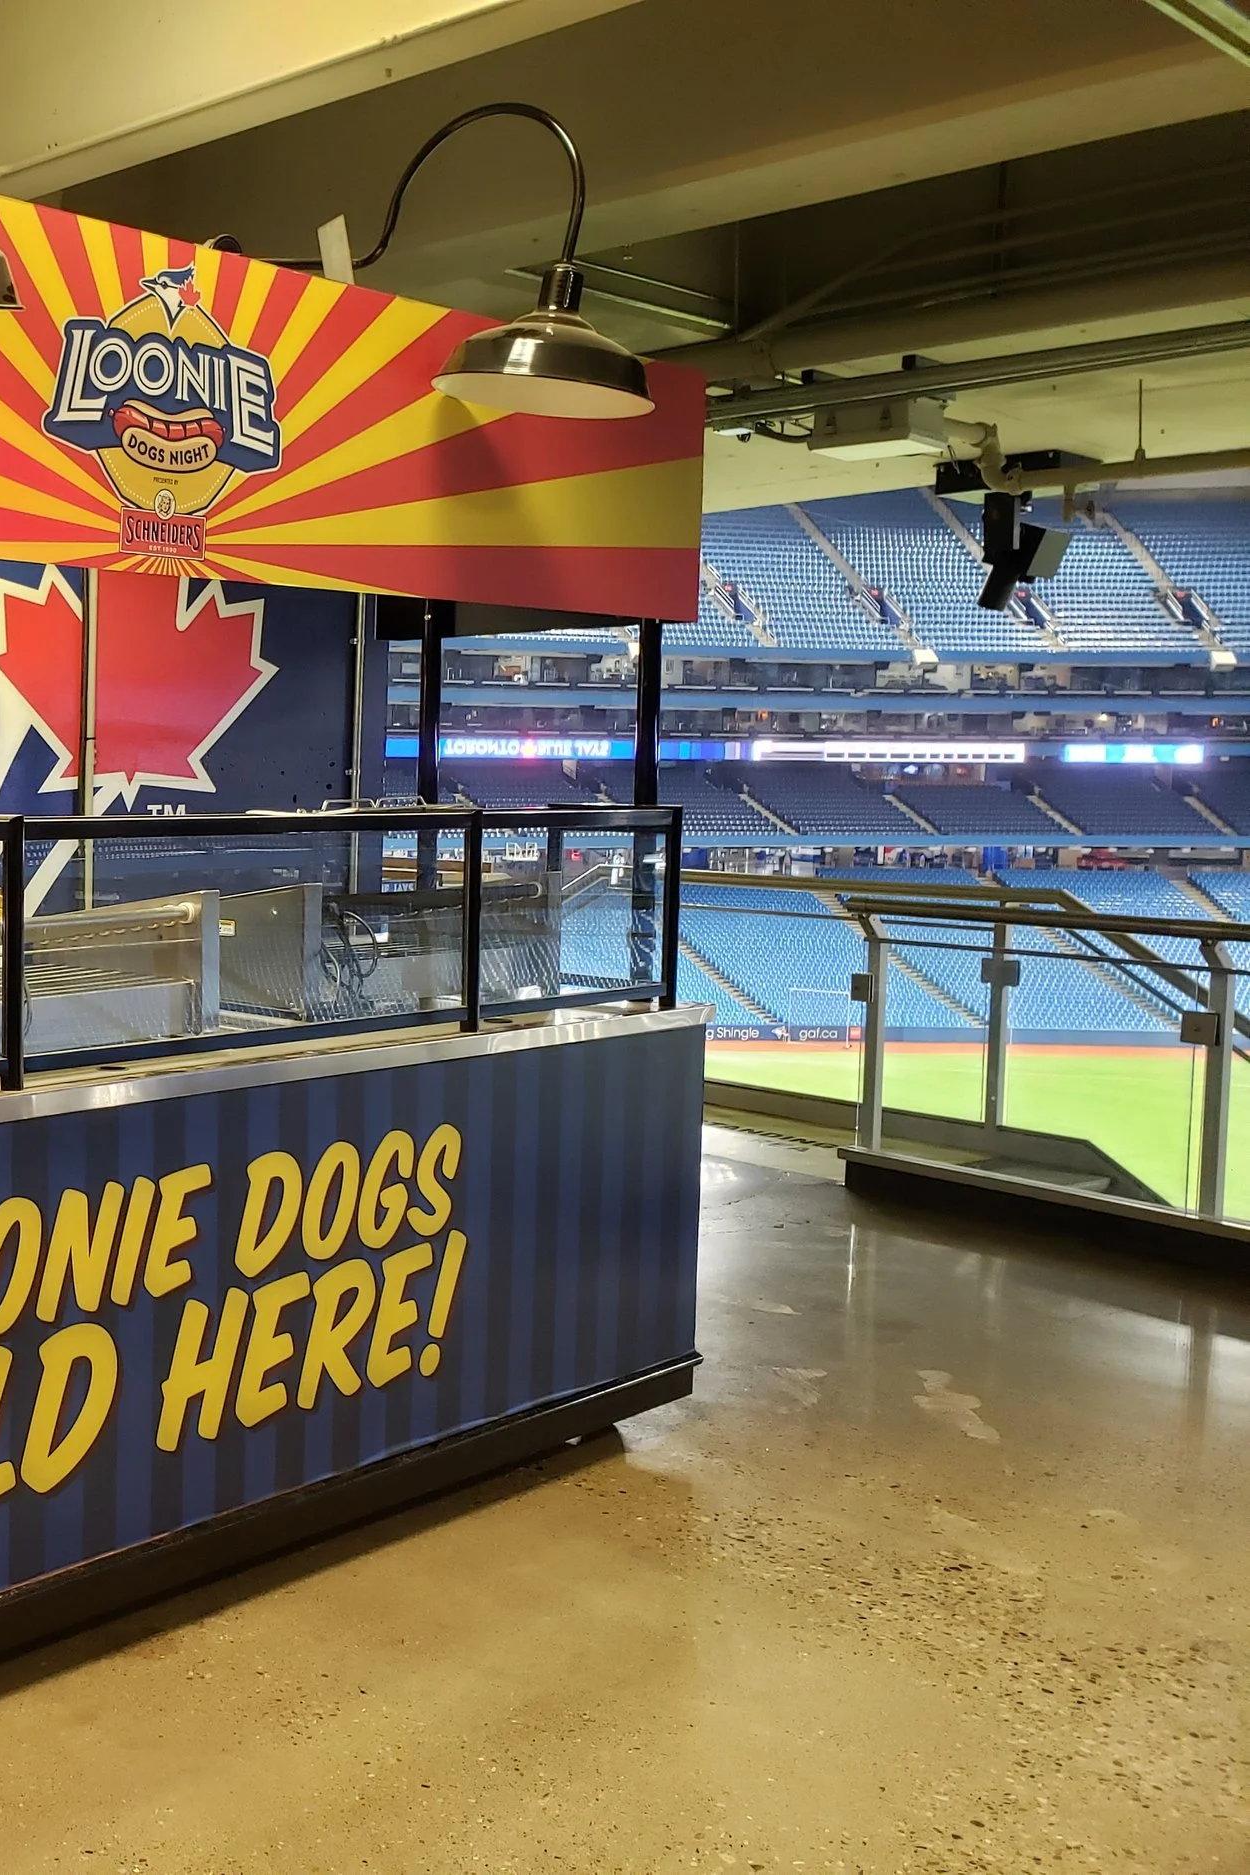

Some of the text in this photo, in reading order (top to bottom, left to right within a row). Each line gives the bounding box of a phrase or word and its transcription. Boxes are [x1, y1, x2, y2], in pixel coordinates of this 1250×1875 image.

[52, 328, 275, 457] LOONIE
[127, 433, 209, 466] DOGS NIGHT
[123, 514, 201, 553] SCHNEIDERS
[148, 544, 161, 552] EST
[716, 1026, 760, 1040] Shingle
[799, 1028, 838, 1041] gaf.ca
[234, 1122, 462, 1278] DOGS
[155, 1228, 467, 1453] HERE!
